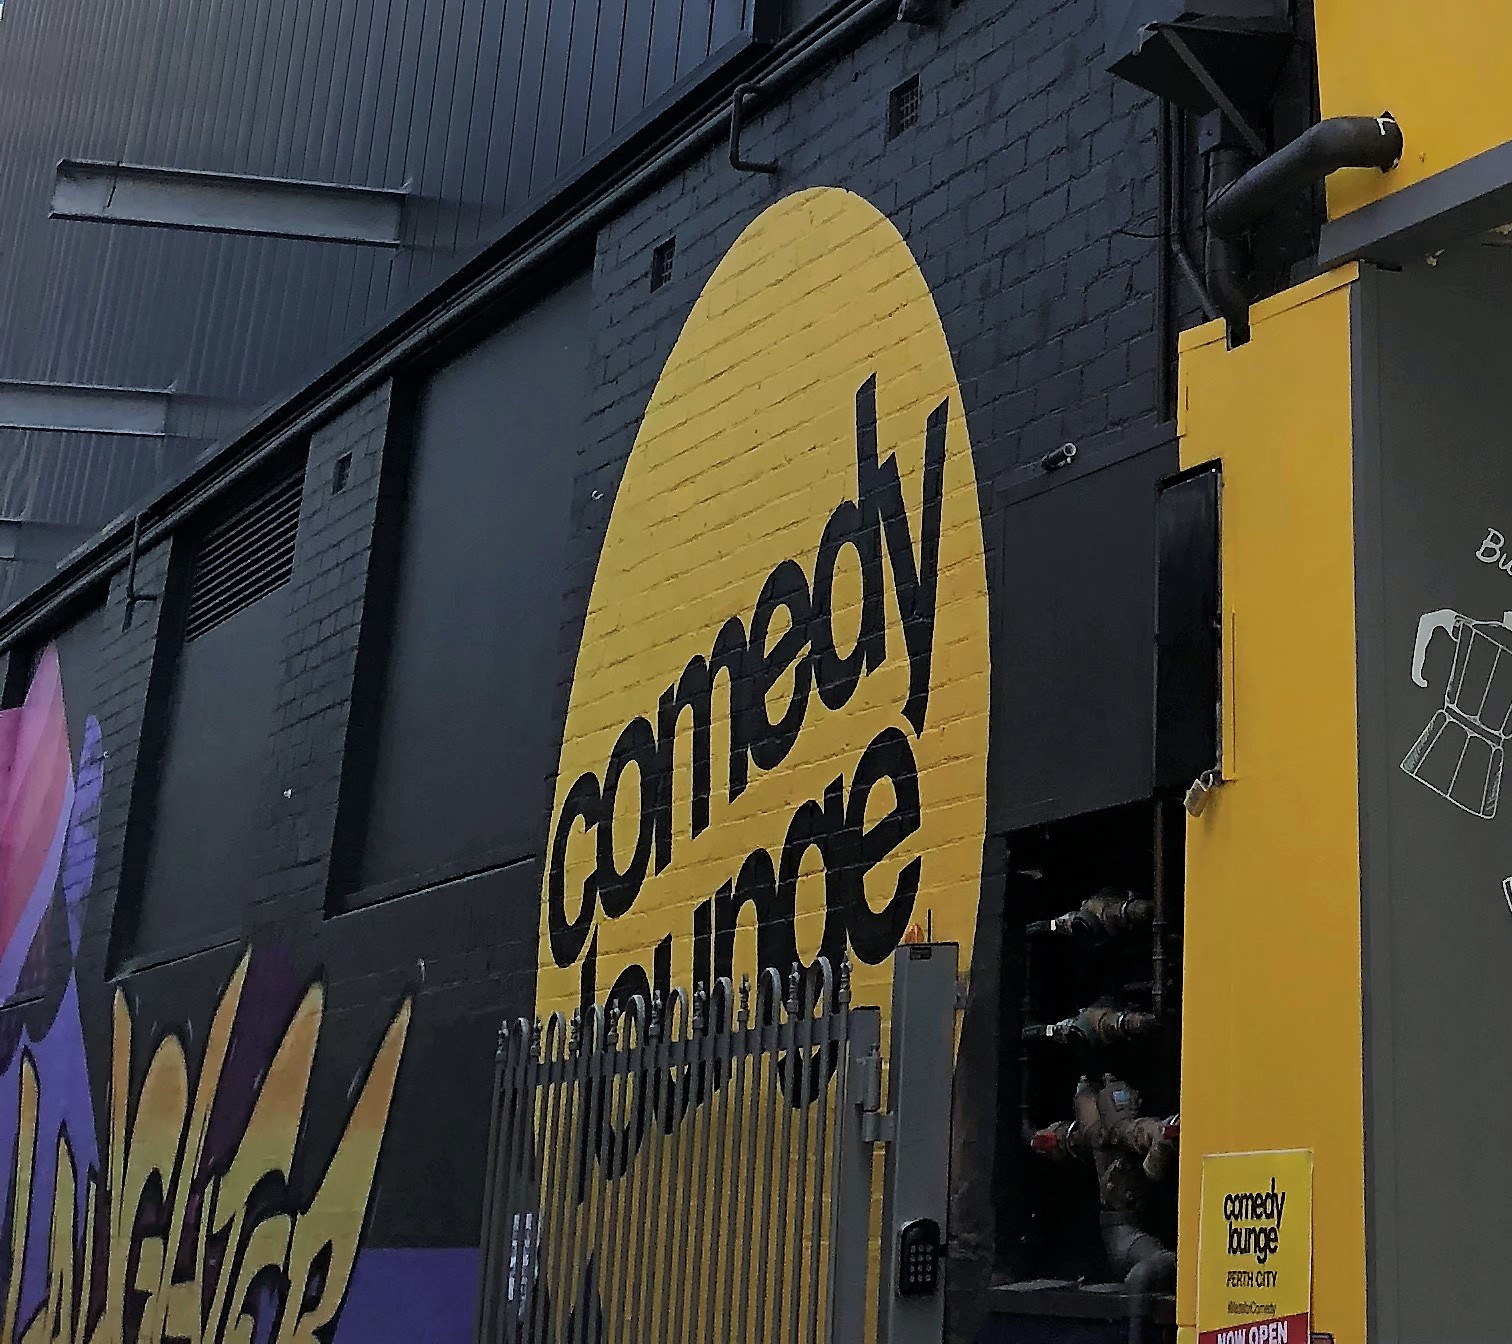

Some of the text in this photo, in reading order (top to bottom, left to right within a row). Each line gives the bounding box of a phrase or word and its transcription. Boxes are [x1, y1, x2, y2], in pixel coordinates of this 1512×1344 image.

[548, 373, 950, 968] comedy
[1223, 1177, 1286, 1228] comedy
[1227, 1221, 1279, 1264] lounge
[1226, 1270, 1278, 1288] PERTH CITY
[1248, 1320, 1289, 1344] OPEN
